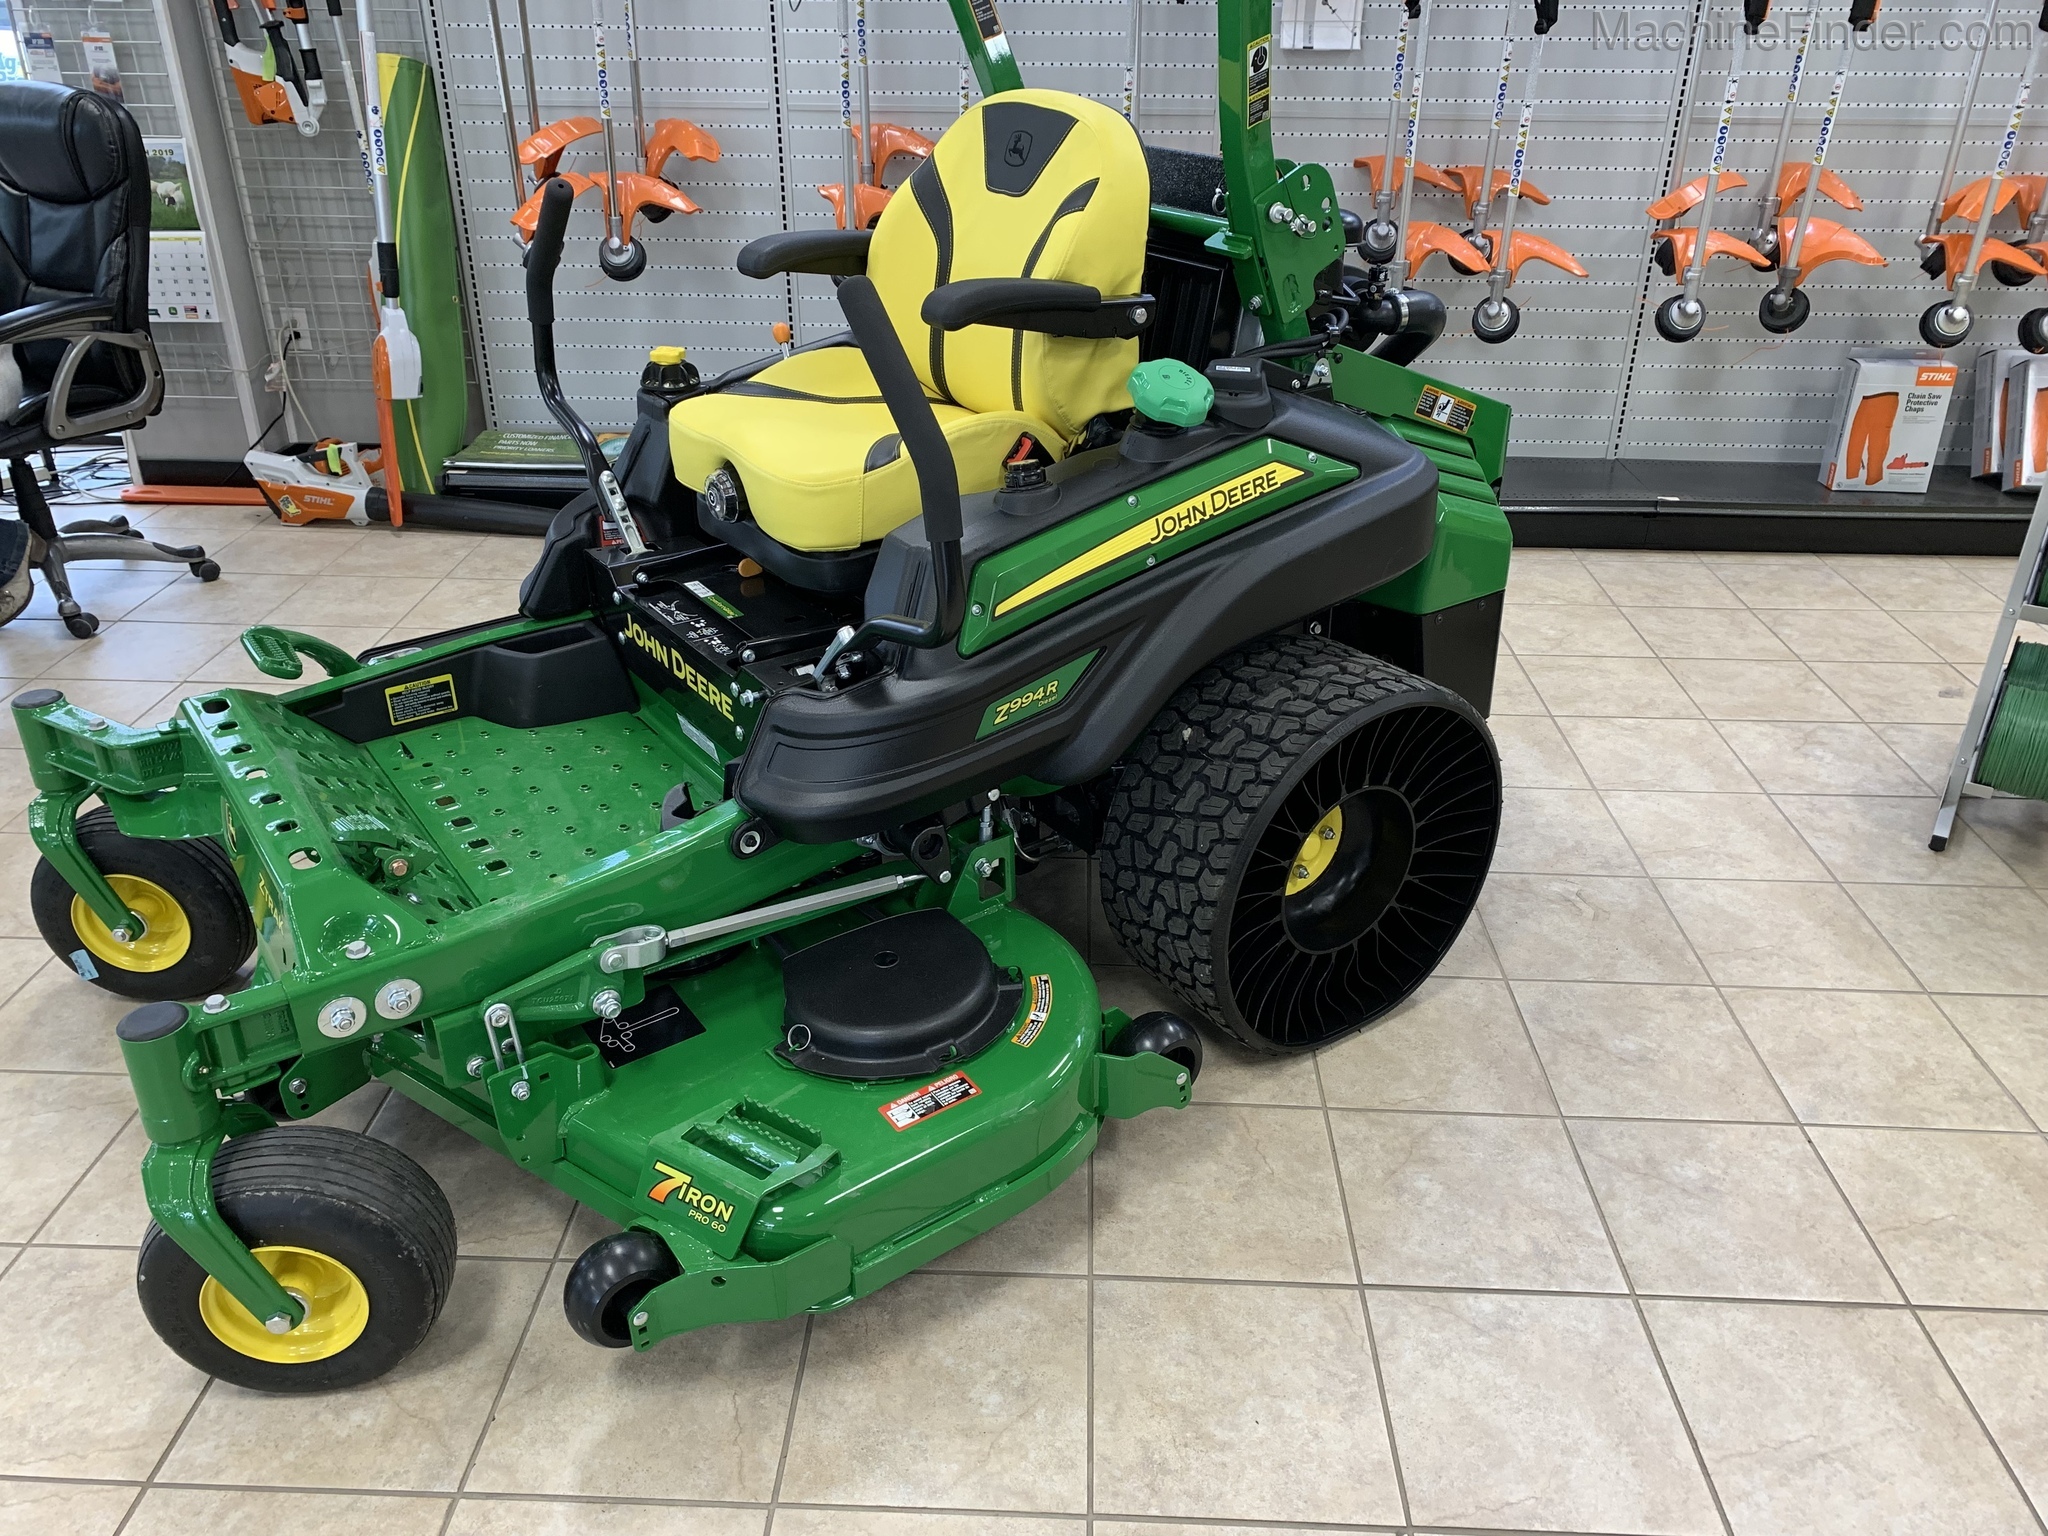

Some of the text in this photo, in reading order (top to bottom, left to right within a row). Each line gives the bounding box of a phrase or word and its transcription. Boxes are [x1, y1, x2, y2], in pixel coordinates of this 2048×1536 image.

[1920, 372, 1952, 381] STIHL
[304, 495, 334, 506] STIHL
[1150, 470, 1278, 541] JOHN DEERE
[624, 613, 734, 722] JOHN DEERE
[994, 680, 1058, 725] Z994R
[1038, 694, 1057, 707] Diesel
[259, 872, 284, 935] ZTRAK
[934, 1074, 958, 1088] PELIGRO
[897, 1091, 921, 1105] DANGER
[688, 1209, 726, 1233] PRO 60
